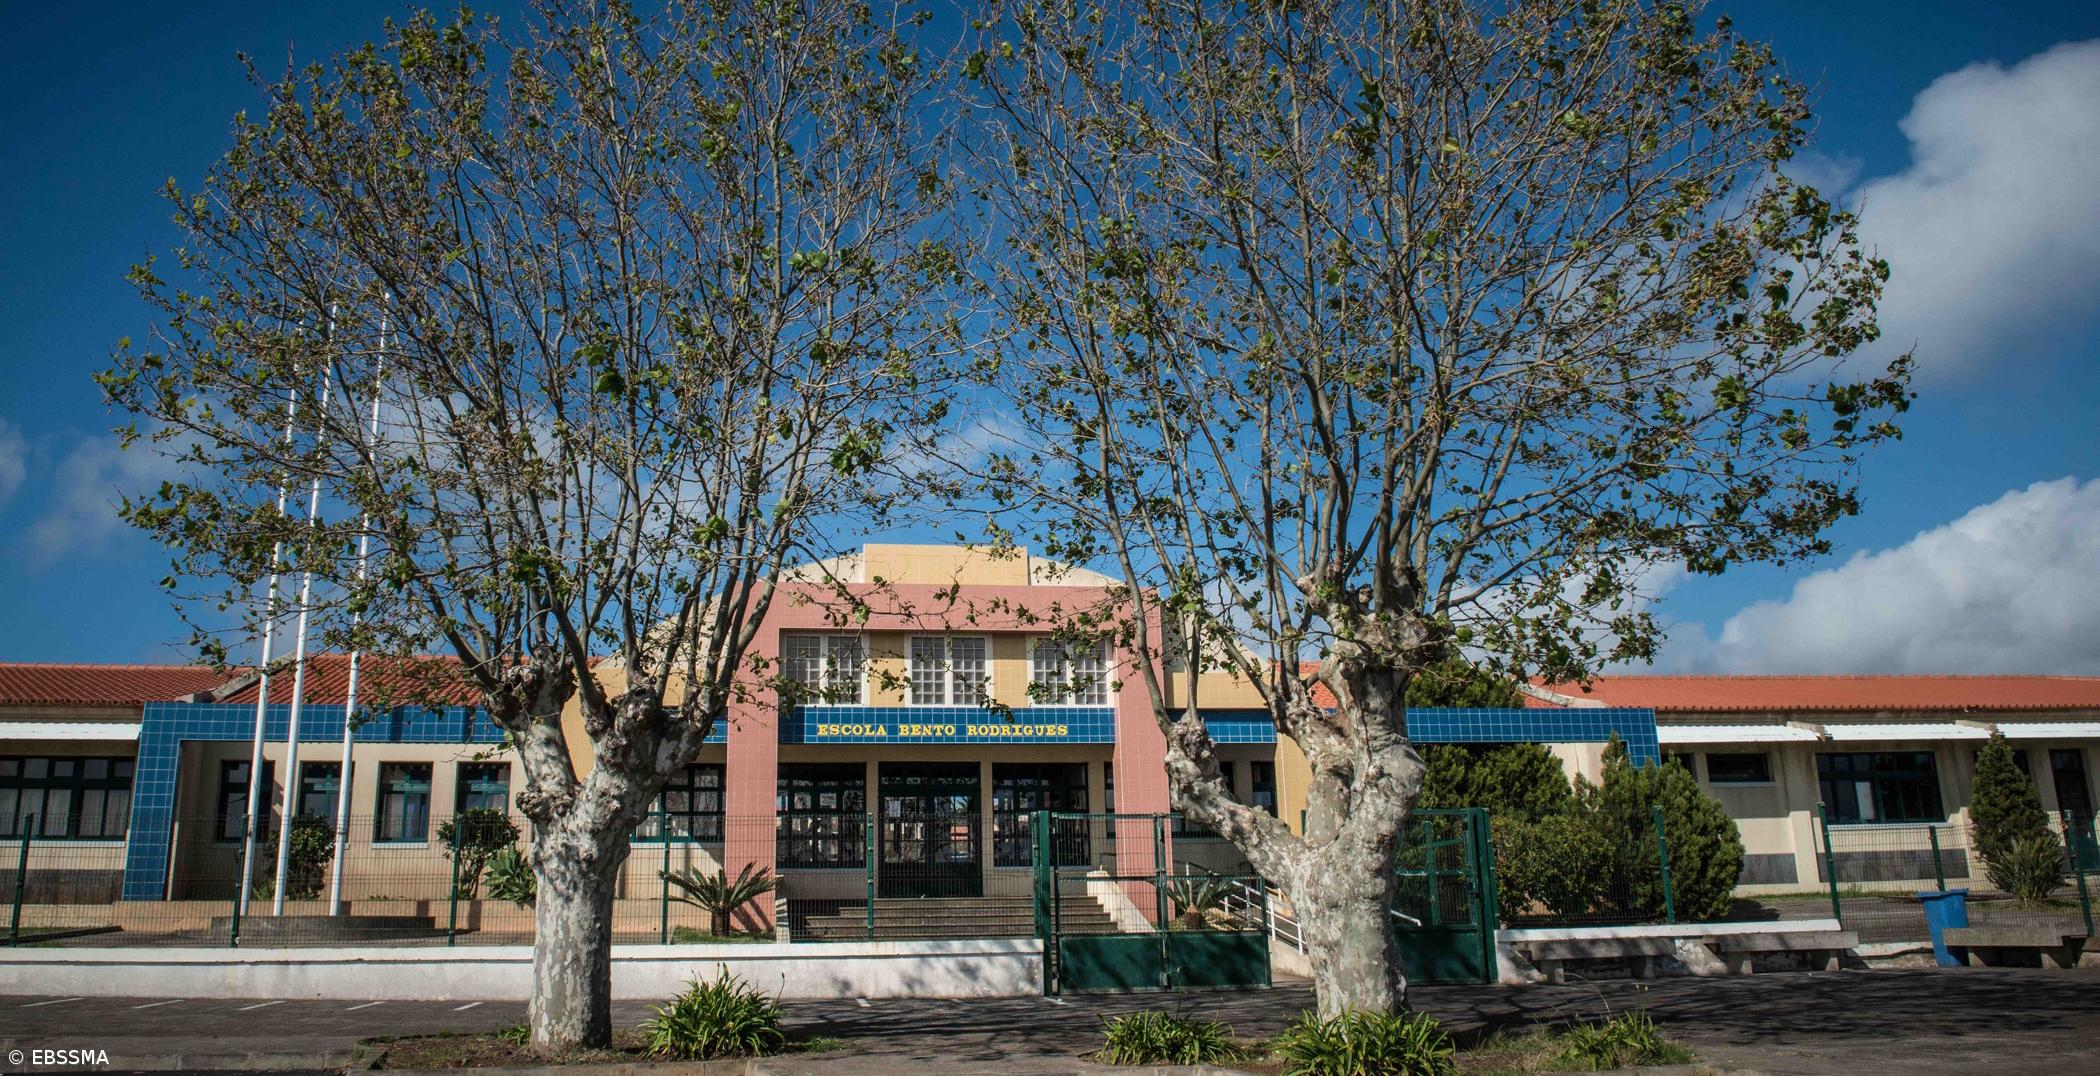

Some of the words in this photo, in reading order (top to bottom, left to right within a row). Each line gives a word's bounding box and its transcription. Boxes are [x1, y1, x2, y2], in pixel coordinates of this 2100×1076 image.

[817, 724, 887, 736] ESCOLA
[899, 724, 956, 736] BENTO
[967, 724, 1068, 736] RODRIGUES
